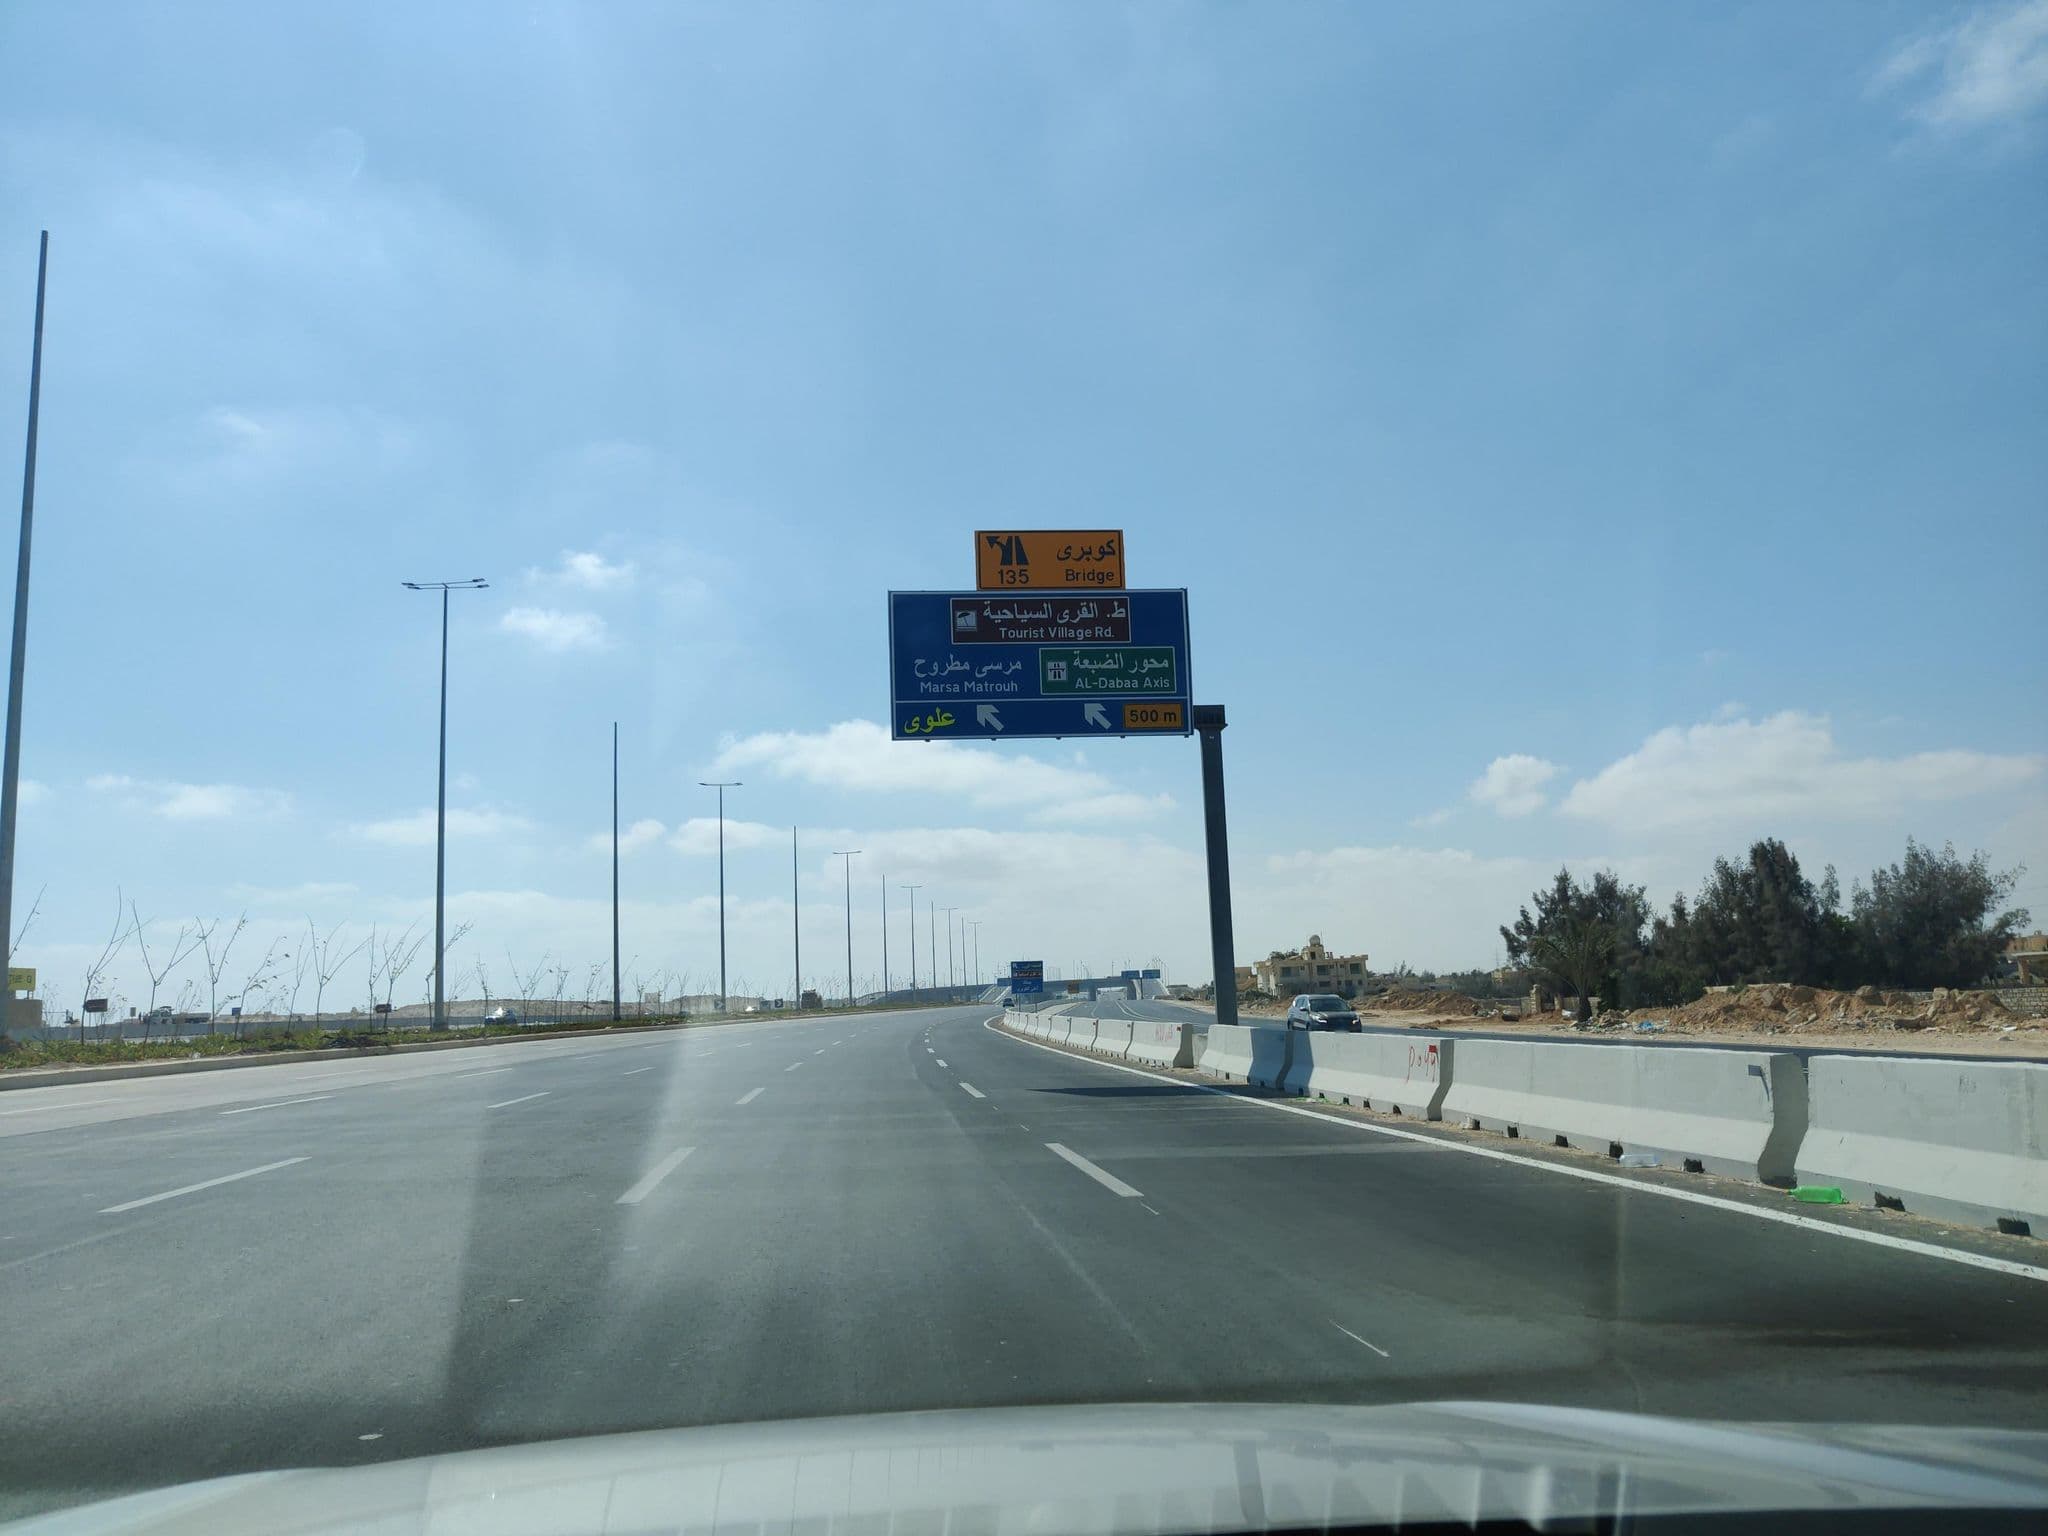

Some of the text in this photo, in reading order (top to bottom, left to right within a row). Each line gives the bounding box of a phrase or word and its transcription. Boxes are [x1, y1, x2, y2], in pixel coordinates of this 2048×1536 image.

[1056, 539, 1116, 562] كوبرى
[998, 569, 1030, 584] 135
[1065, 568, 1115, 584] Bridge
[983, 600, 1126, 623] ط. القرى السياحية
[999, 626, 1115, 640] Tourist Village Rd.
[914, 653, 1022, 678] مرسى مطروح
[1073, 650, 1169, 674] محور الضبعة
[920, 680, 1018, 693] Marsa Matrouh
[1075, 676, 1170, 689] AL-Dabaa Axis
[904, 706, 956, 734] علوى
[1130, 710, 1177, 723] 500 m
